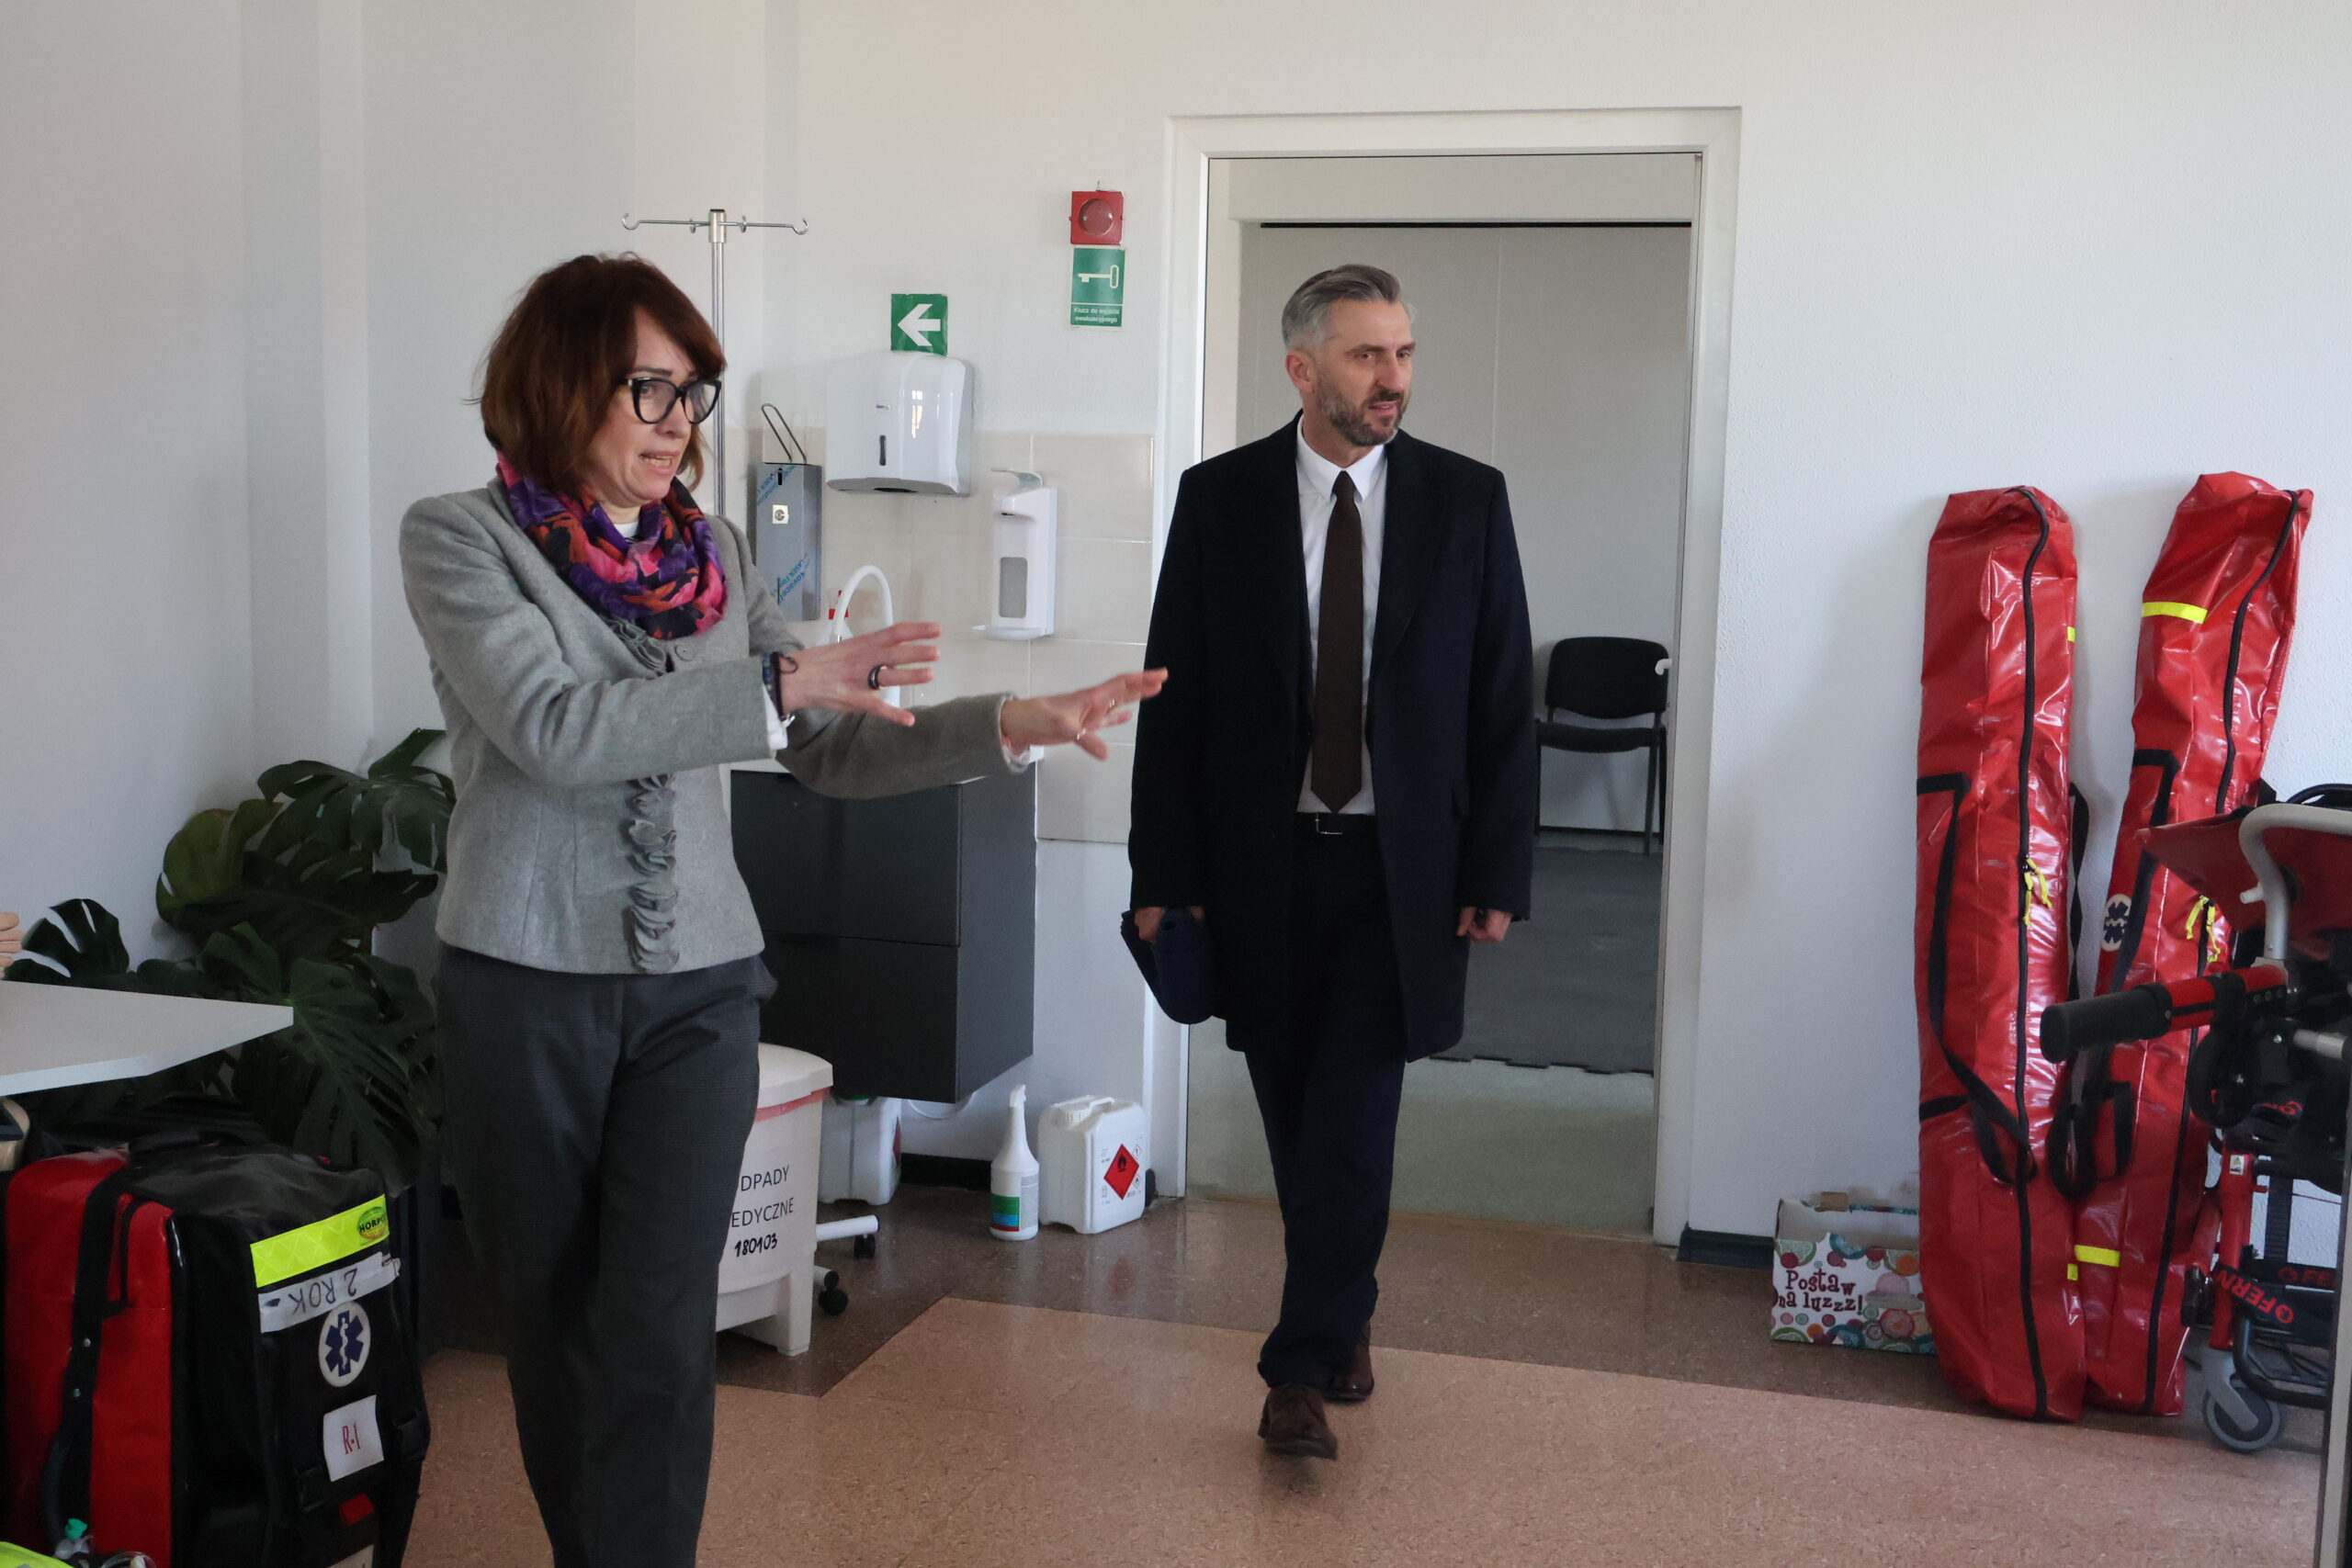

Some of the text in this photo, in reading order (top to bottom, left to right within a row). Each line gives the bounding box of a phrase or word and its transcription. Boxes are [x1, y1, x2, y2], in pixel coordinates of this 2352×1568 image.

[741, 1165, 790, 1192] DPADY
[731, 1197, 795, 1228] EDYCZNE
[344, 1268, 358, 1297] 2
[1785, 1269, 1856, 1296] Postaw
[2216, 1269, 2278, 1314] FERN
[1778, 1292, 1863, 1316] na luzzz!
